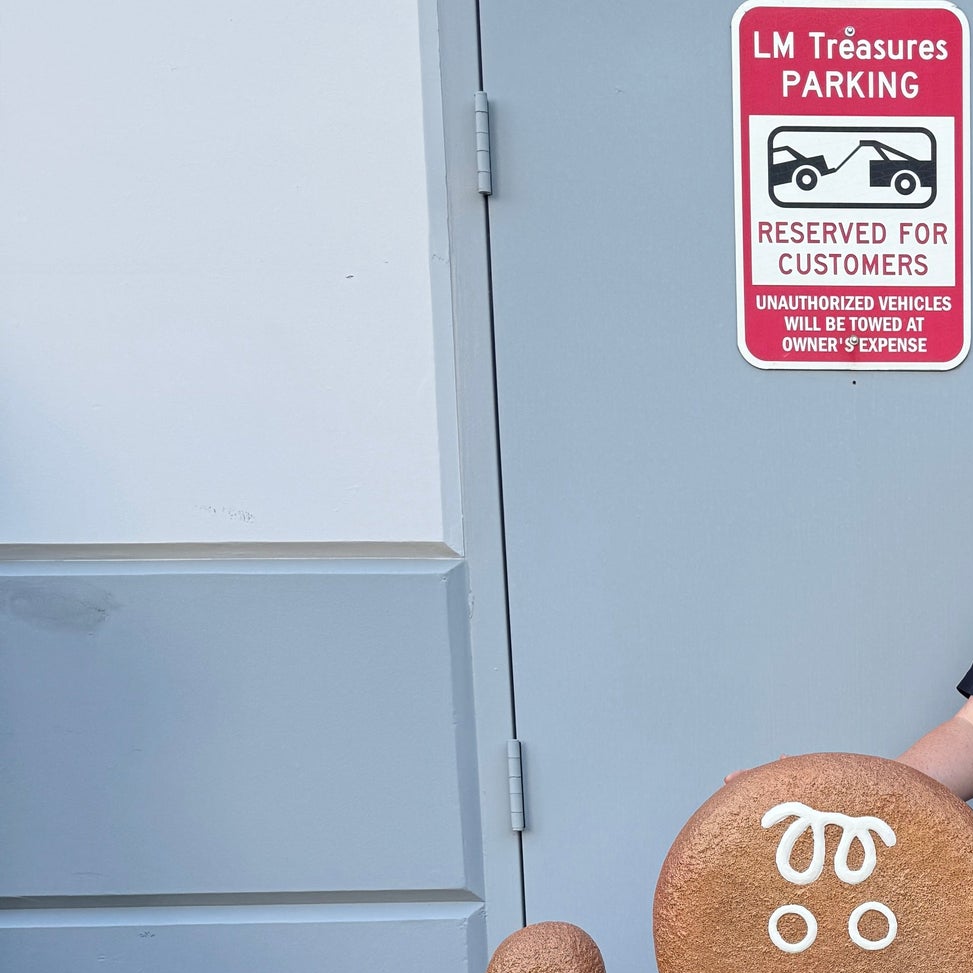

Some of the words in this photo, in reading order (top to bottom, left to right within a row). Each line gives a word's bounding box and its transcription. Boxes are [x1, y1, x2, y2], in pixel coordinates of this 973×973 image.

[753, 31, 794, 59] LM
[808, 32, 948, 61] Treasures
[782, 70, 920, 99] PARKING
[758, 221, 887, 244] RESERVED
[899, 222, 948, 245] FOR
[778, 253, 929, 276] CUSTOMERS
[756, 295, 874, 311] UNAUTHORIZED
[878, 296, 952, 312] VEHICLES
[784, 316, 821, 332] WILL
[825, 316, 846, 332] BE
[849, 317, 902, 332] TOWED
[906, 317, 925, 332] AT
[782, 337, 856, 352] OWNER'S
[859, 337, 928, 353] EXPENSE
